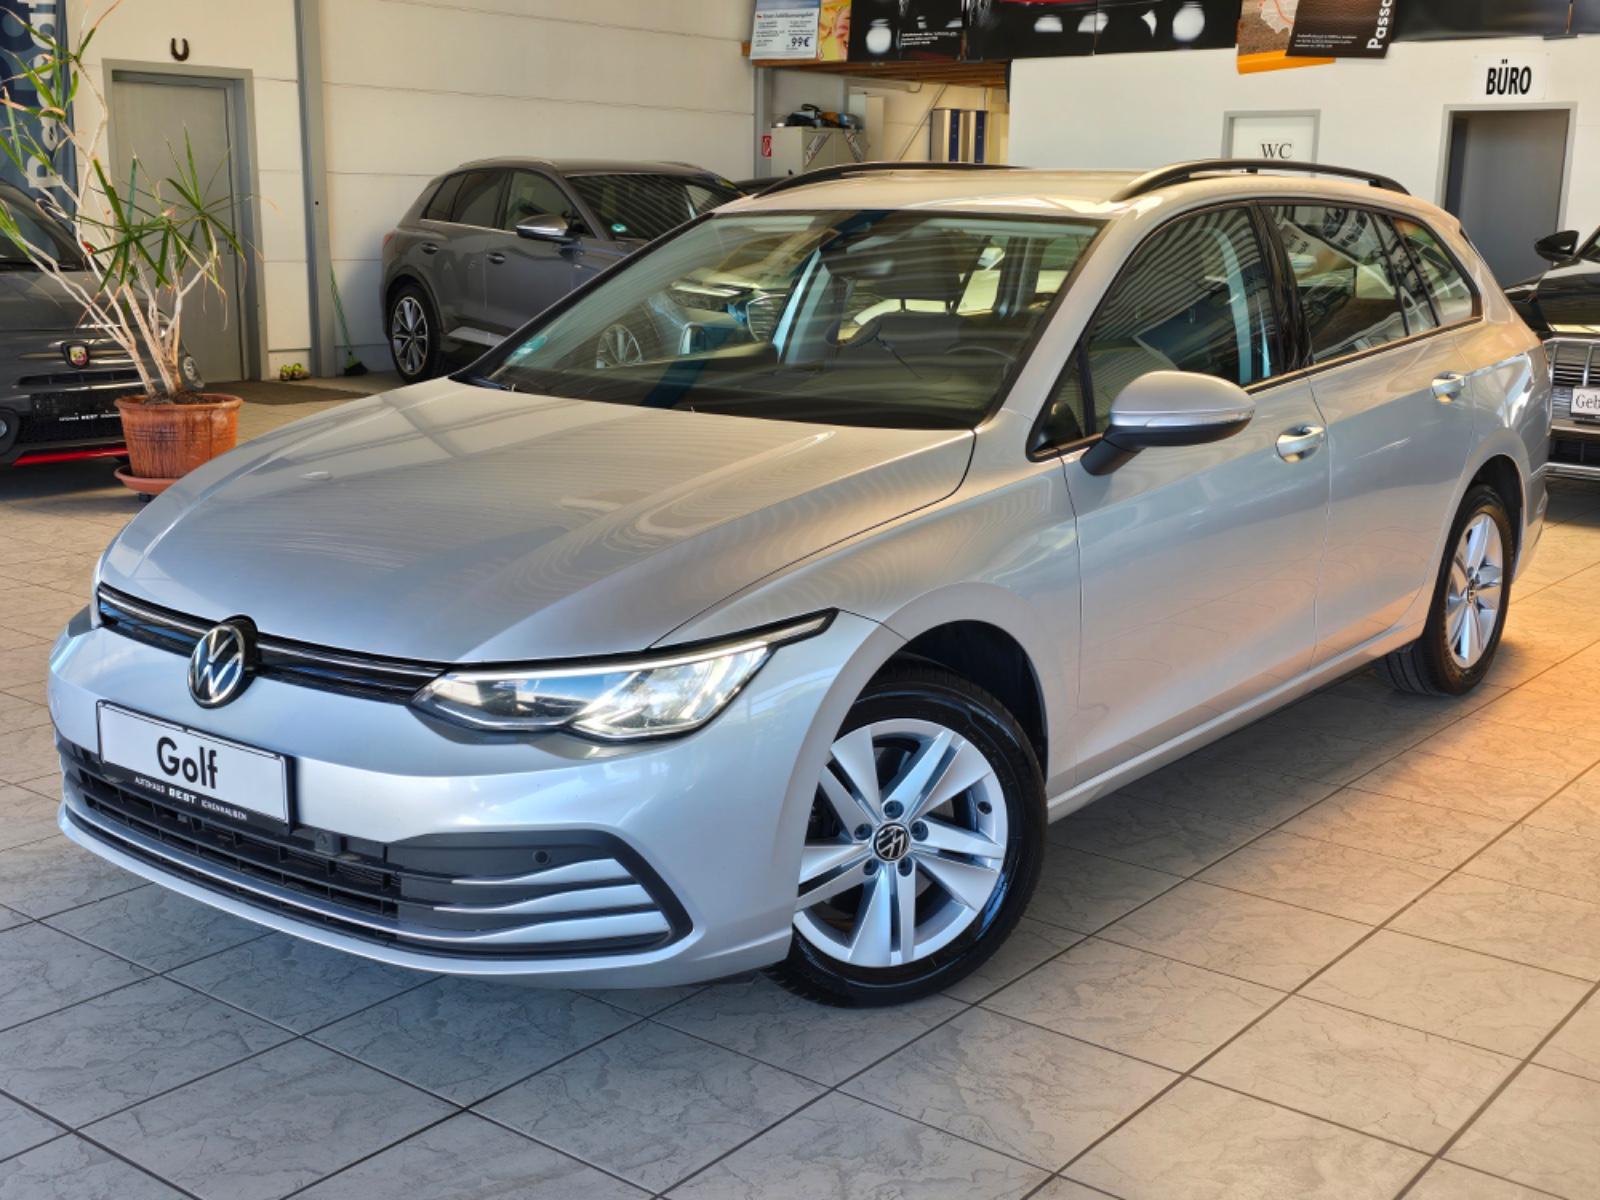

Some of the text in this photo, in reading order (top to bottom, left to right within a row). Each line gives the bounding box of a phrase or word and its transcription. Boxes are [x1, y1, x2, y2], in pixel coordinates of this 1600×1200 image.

[1486, 59, 1532, 95] BÜRO
[1261, 143, 1292, 159] WC
[157, 736, 218, 789] Golf
